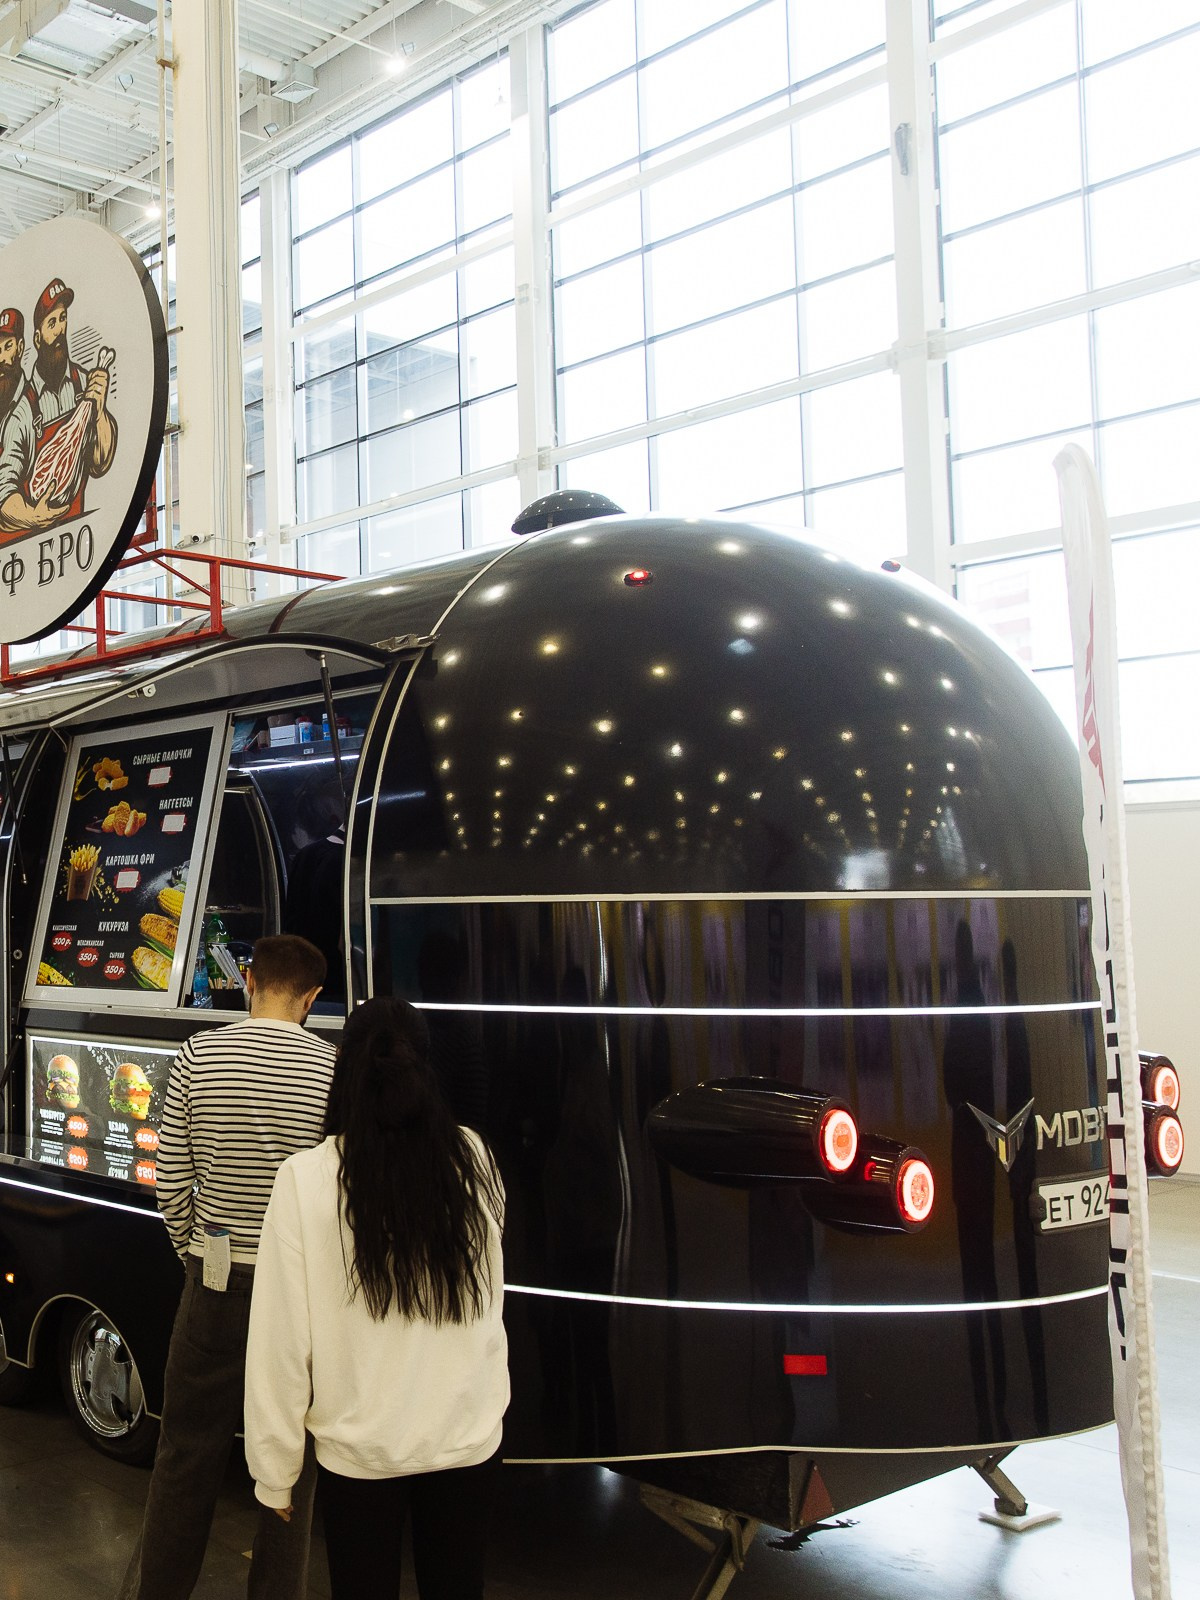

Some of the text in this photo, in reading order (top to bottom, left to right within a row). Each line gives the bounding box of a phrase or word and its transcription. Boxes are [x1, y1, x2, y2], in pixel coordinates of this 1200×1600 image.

[38, 524, 94, 587] БРО
[133, 748, 192, 766] СЫРНЫЕ ПАЛОЧКИ
[159, 797, 193, 810] НАГГЕТСЫ
[105, 853, 155, 866] КАРТОШКА ФРИ
[98, 921, 129, 932] КУКУРУЗА
[136, 1133, 152, 1143] 650
